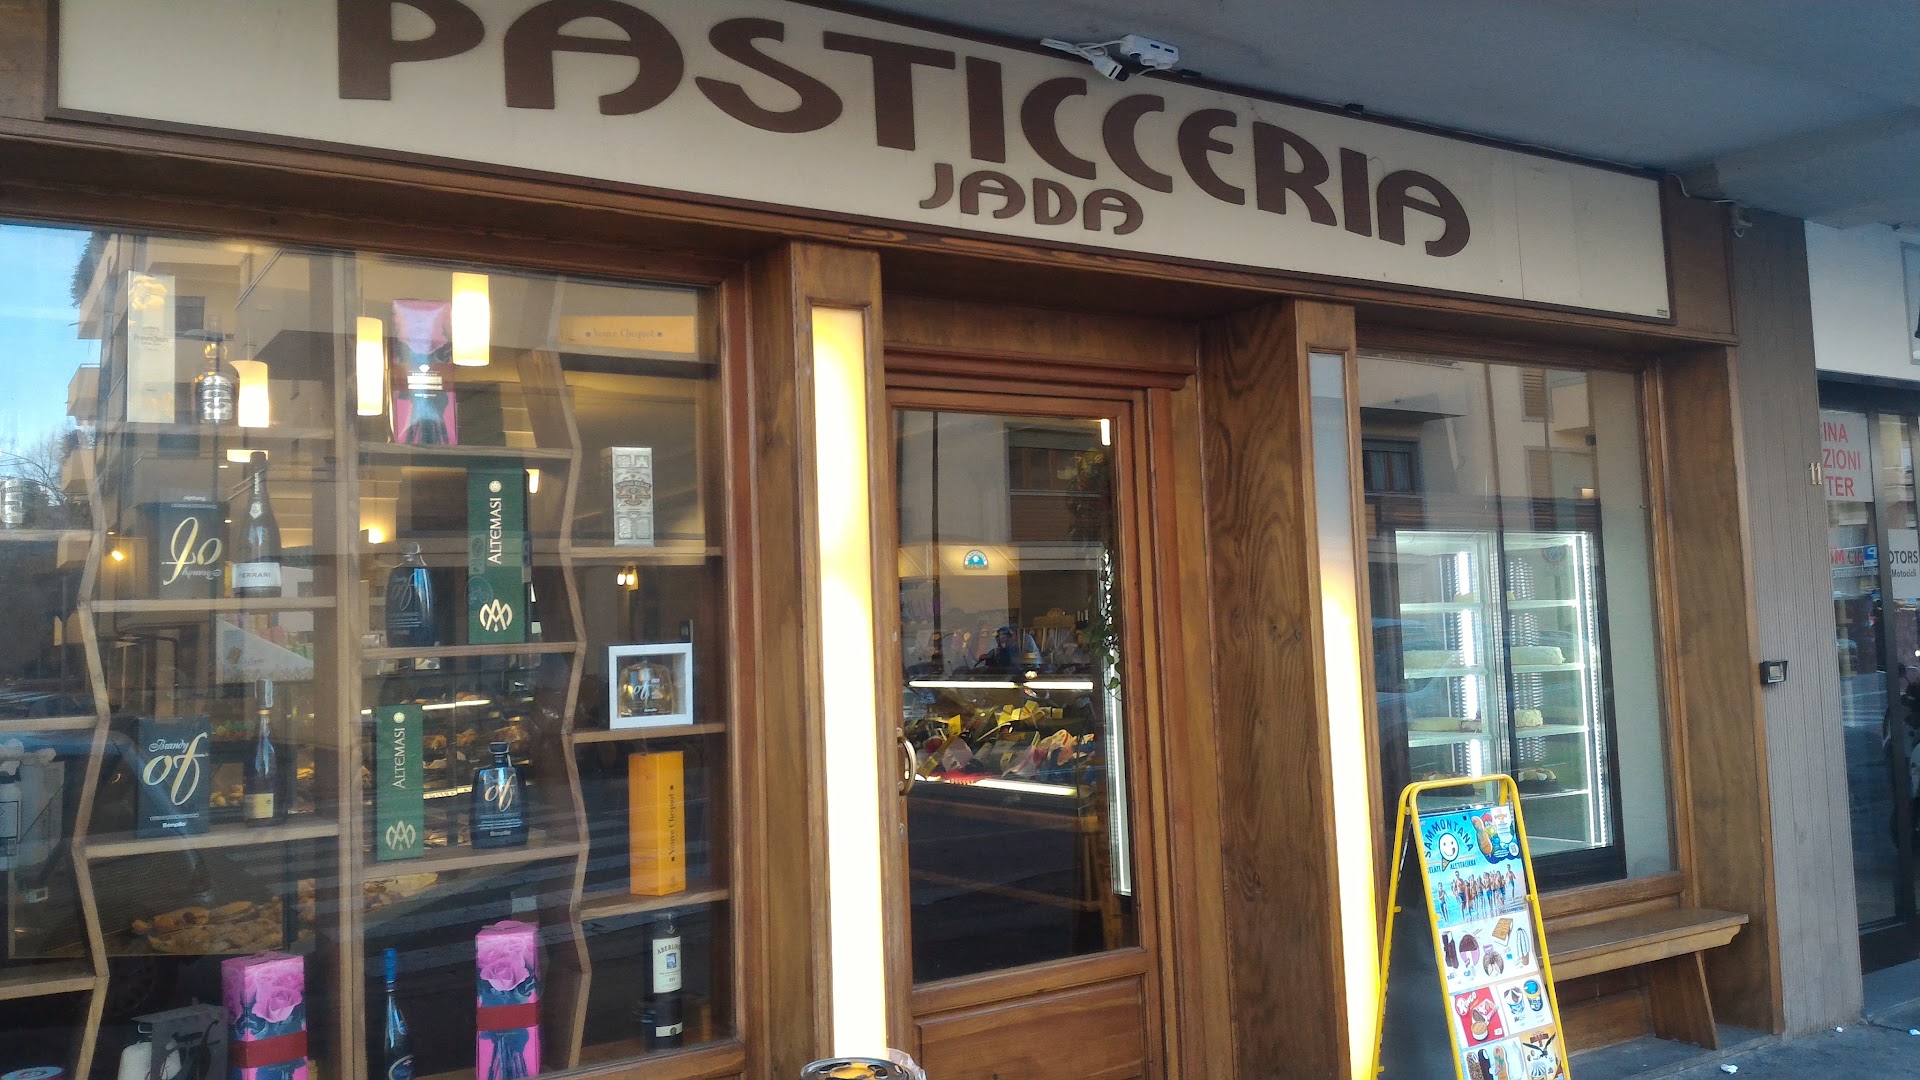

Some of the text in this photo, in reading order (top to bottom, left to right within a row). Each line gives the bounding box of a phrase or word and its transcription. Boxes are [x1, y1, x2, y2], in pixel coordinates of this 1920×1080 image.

[337, 0, 1471, 258] PASTICCERIA
[919, 163, 1144, 236] JADA
[1808, 462, 1823, 485] 11
[1823, 448, 1861, 470] ZIONI
[1825, 475, 1856, 497] TER
[487, 497, 502, 565] ALTEMASI
[148, 738, 189, 753] Brandy
[392, 726, 406, 790] ALTEMASI
[142, 732, 209, 806] of
[484, 773, 516, 812] of
[1424, 819, 1474, 859] SAMMONTANA
